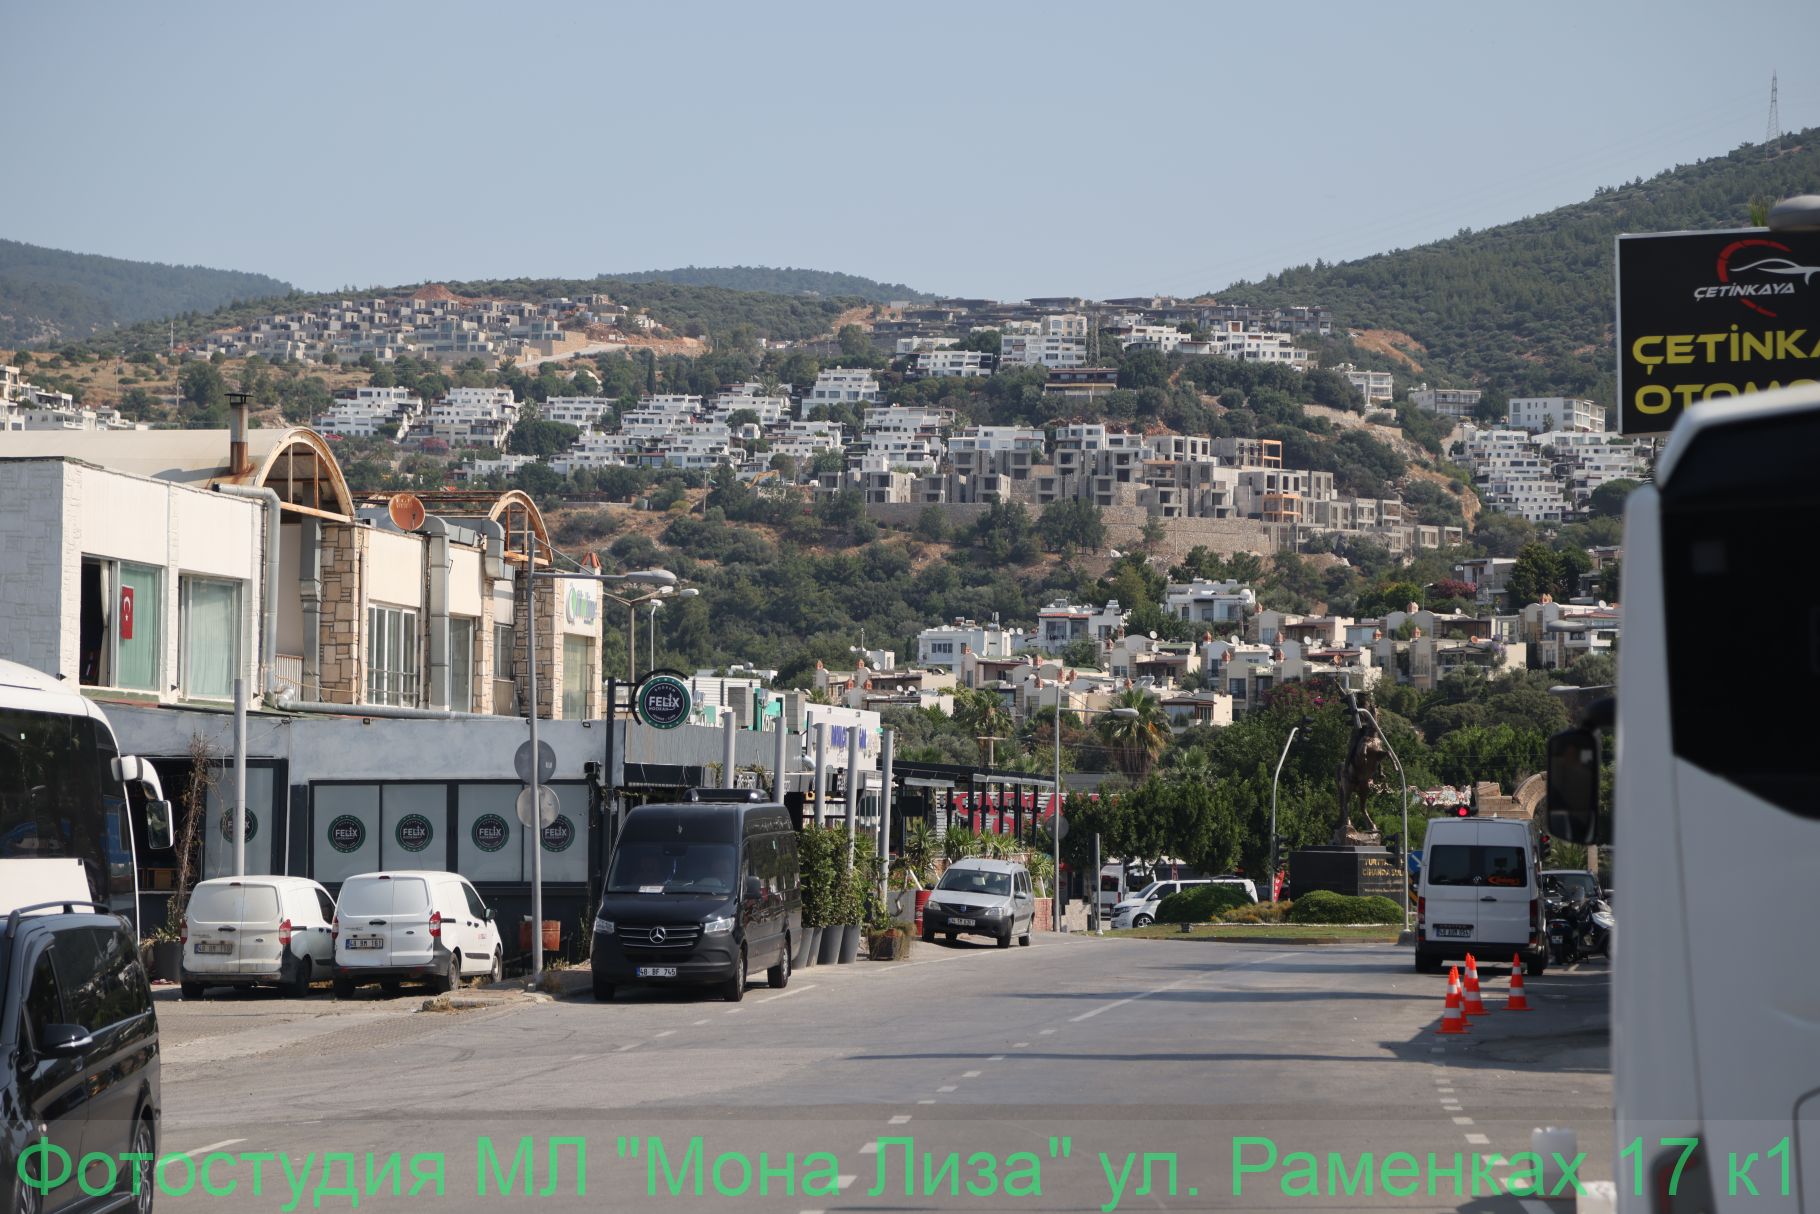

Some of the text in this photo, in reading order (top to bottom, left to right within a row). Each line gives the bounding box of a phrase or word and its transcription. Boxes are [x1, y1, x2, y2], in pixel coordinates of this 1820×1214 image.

[1693, 282, 1796, 302] ÇETİNKAYA
[640, 968, 648, 976] 48
[664, 968, 676, 976] 745
